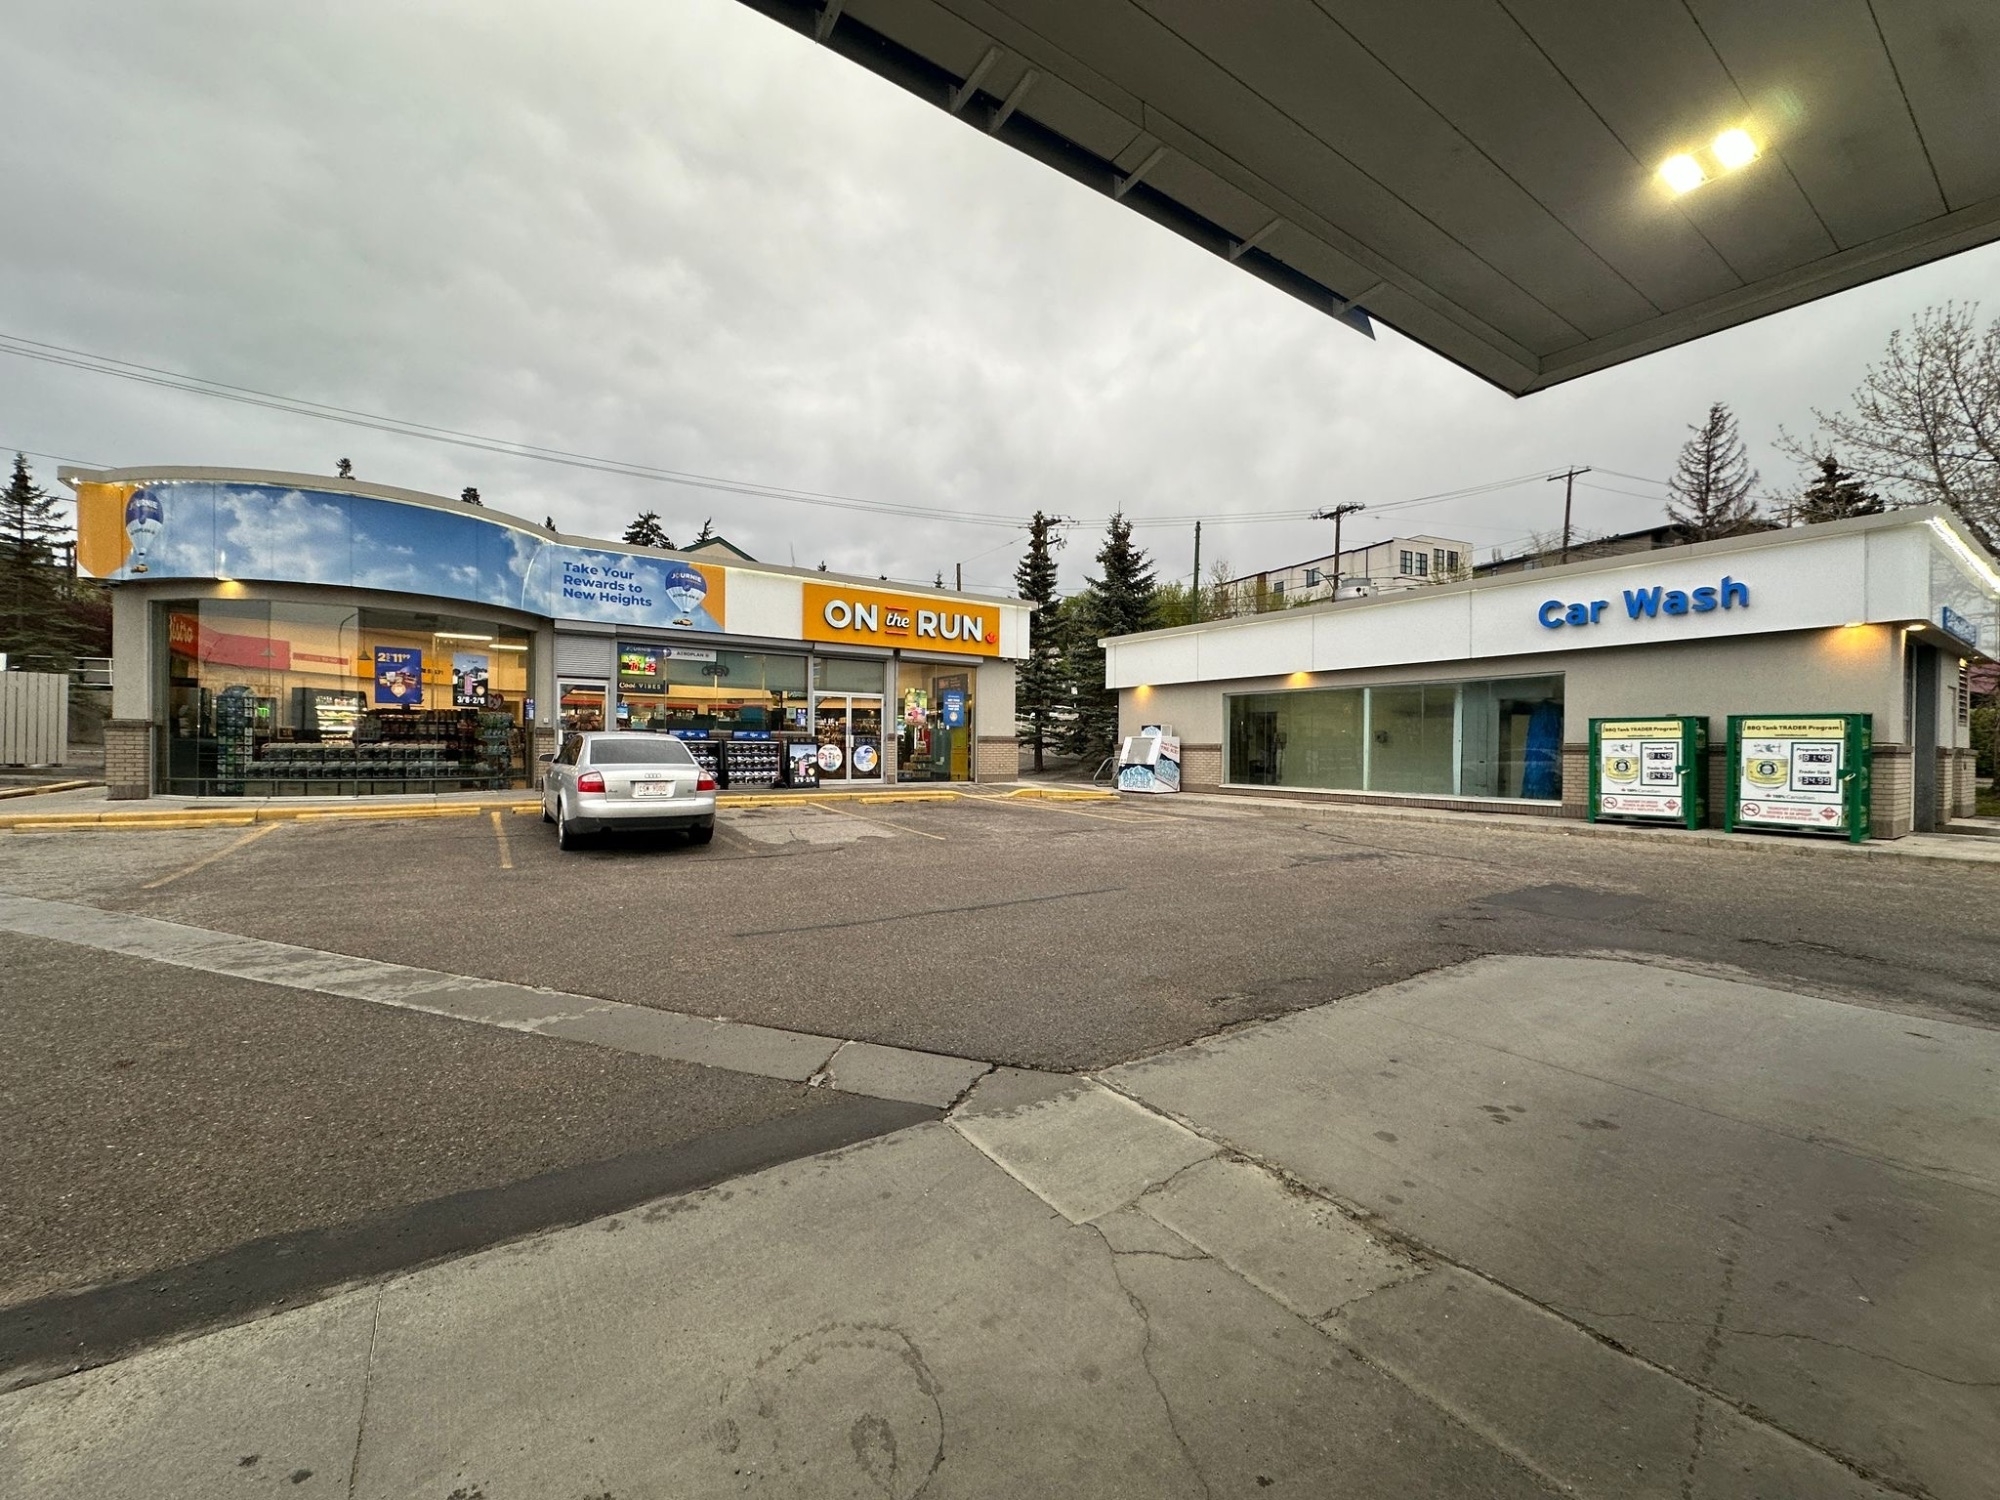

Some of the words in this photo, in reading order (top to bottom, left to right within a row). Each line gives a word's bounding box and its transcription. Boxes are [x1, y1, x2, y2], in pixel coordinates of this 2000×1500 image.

[563, 561, 598, 575] Take
[602, 566, 634, 580] Your
[671, 572, 702, 583] JOURNIE
[563, 575, 625, 592] Rewards
[628, 583, 643, 594] to
[563, 587, 596, 601] New
[600, 591, 652, 607] Heights
[1538, 599, 1609, 629] Car
[1623, 575, 1749, 620] Wash
[824, 599, 878, 632] ON
[886, 612, 910, 628] the
[917, 610, 983, 642] RUN
